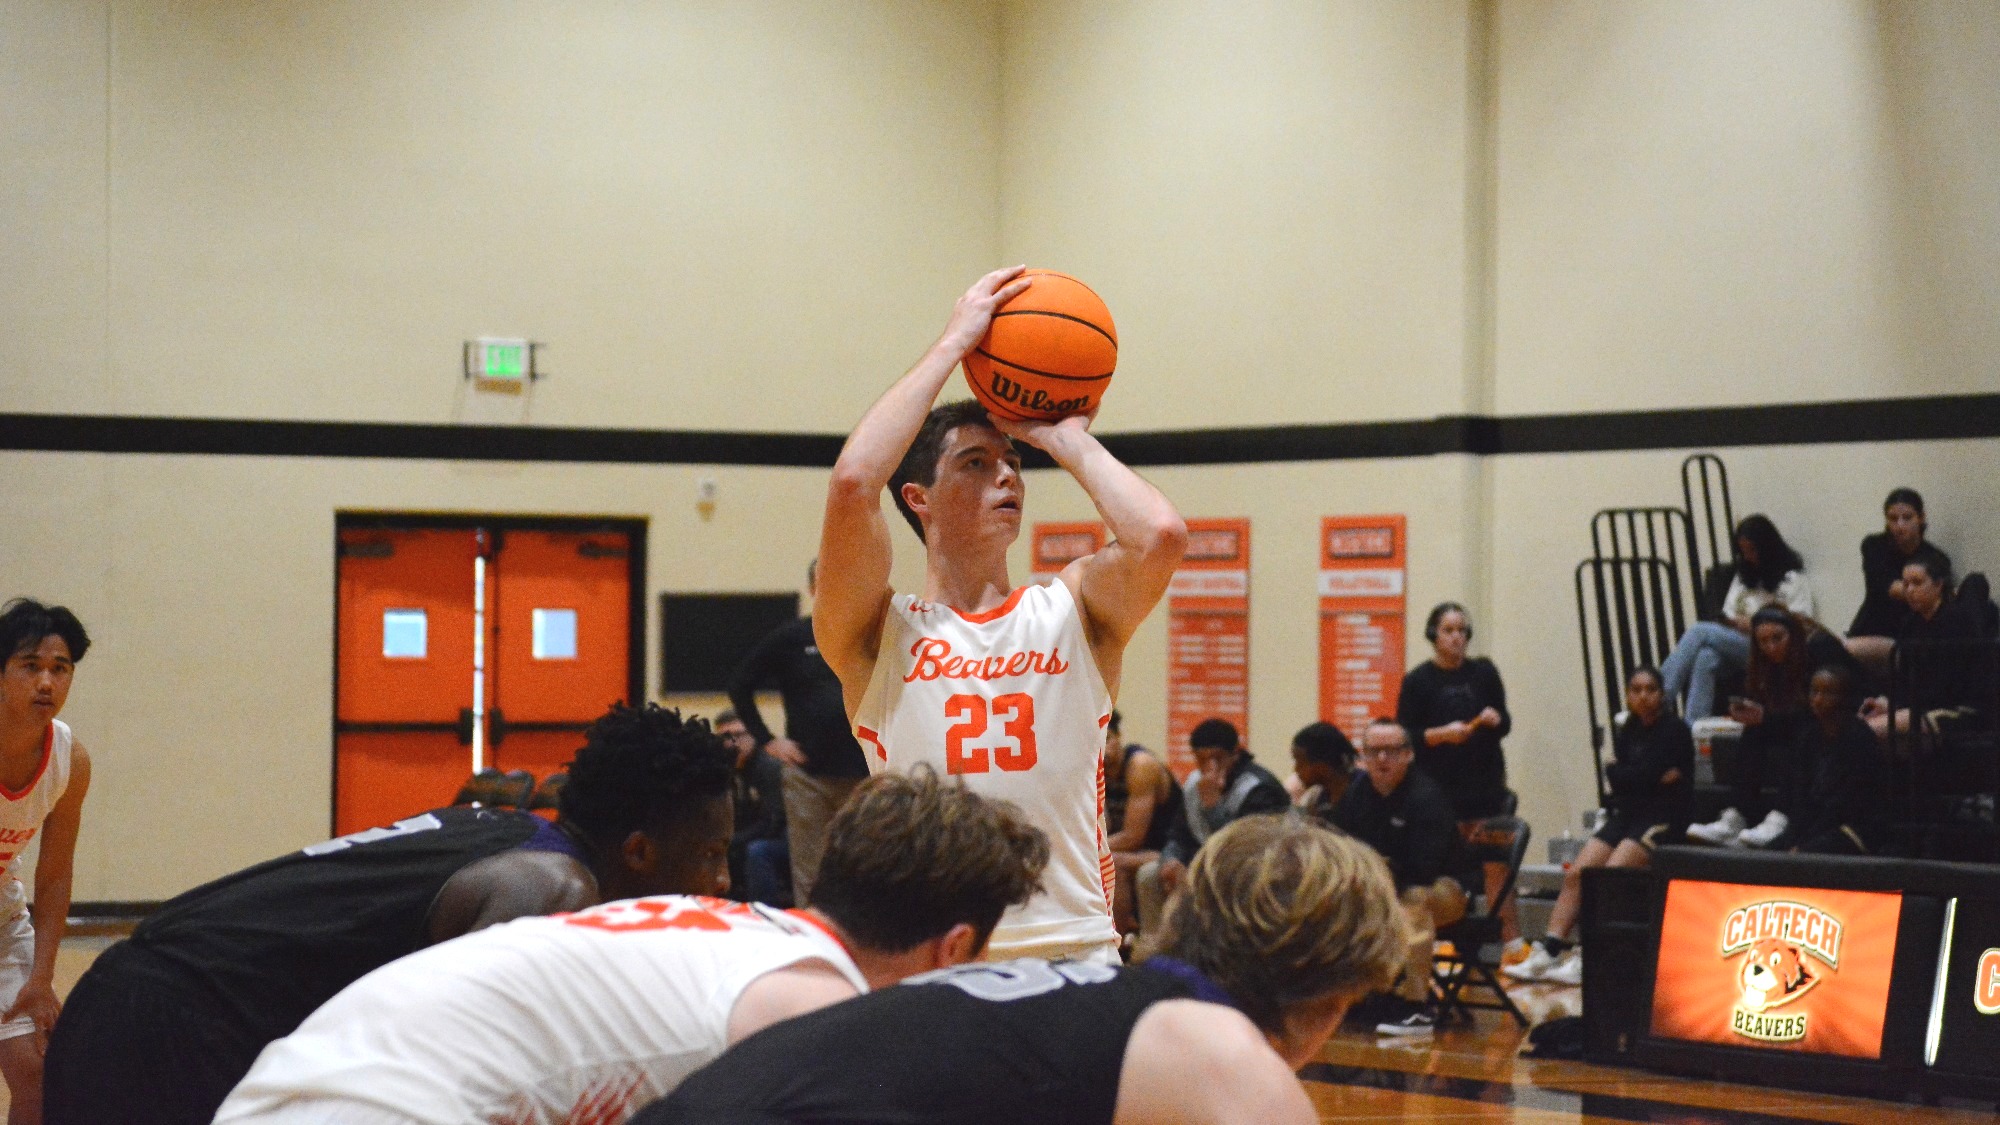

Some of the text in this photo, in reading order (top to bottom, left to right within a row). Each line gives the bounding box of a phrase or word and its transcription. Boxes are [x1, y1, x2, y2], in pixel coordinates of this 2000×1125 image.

[991, 370, 1090, 412] Wilson
[903, 637, 1069, 683] Beavers
[944, 692, 1038, 775] 23
[1723, 902, 1842, 967] CALTECH
[1735, 1010, 1805, 1039] BEAVERS
